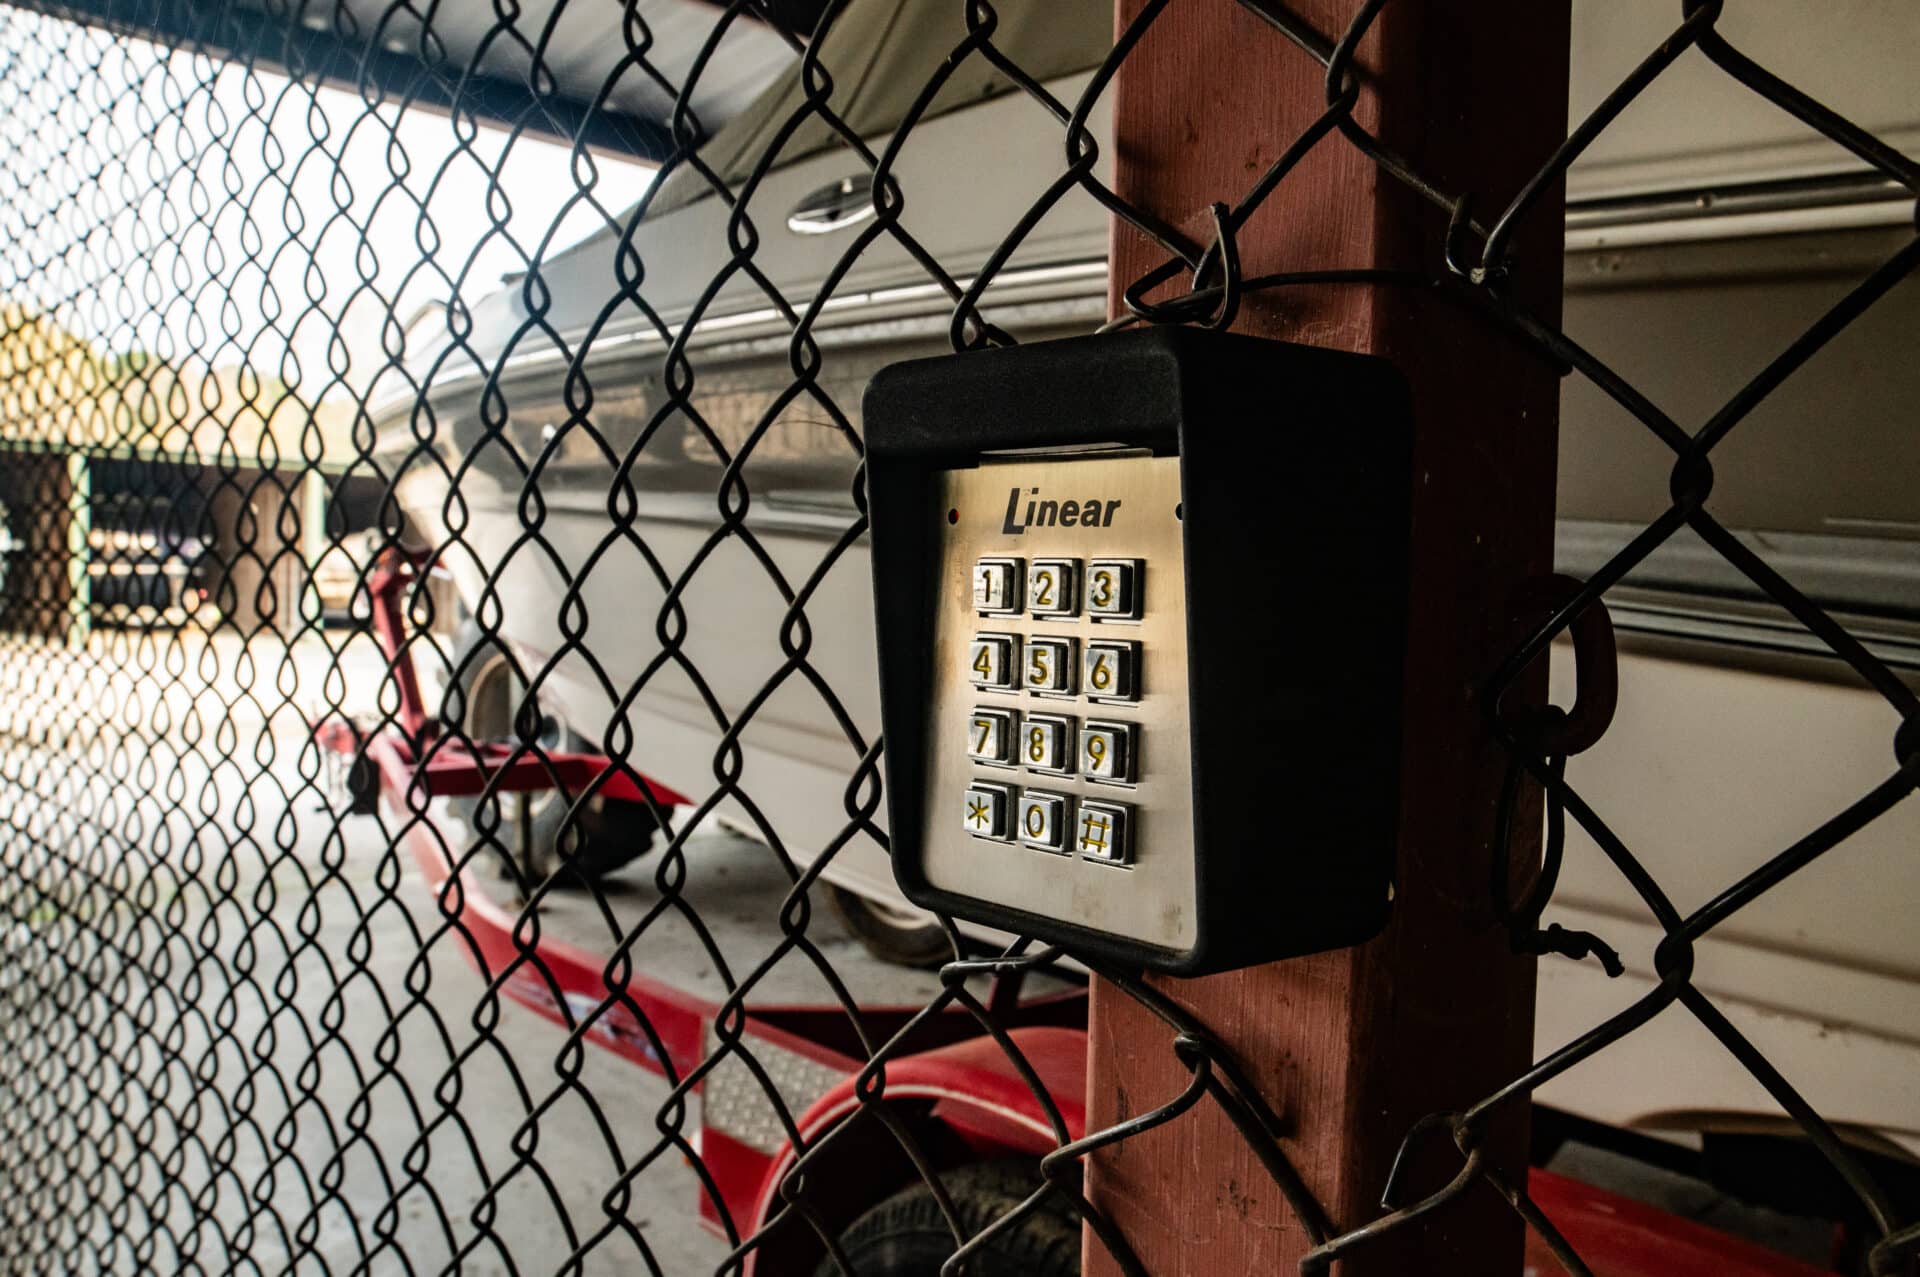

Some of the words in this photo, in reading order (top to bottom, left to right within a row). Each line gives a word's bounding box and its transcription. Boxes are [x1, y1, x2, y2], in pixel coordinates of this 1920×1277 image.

[1002, 488, 1121, 534] Linear
[982, 570, 991, 603] 1
[1036, 570, 1053, 605] 2
[1094, 570, 1112, 606] 3
[973, 645, 992, 680] 4
[1030, 649, 1048, 684] 5
[1091, 654, 1110, 689] 6
[974, 720, 992, 754] 7
[1029, 727, 1044, 762] 8
[1087, 735, 1106, 770] 9
[1080, 813, 1110, 853] #
